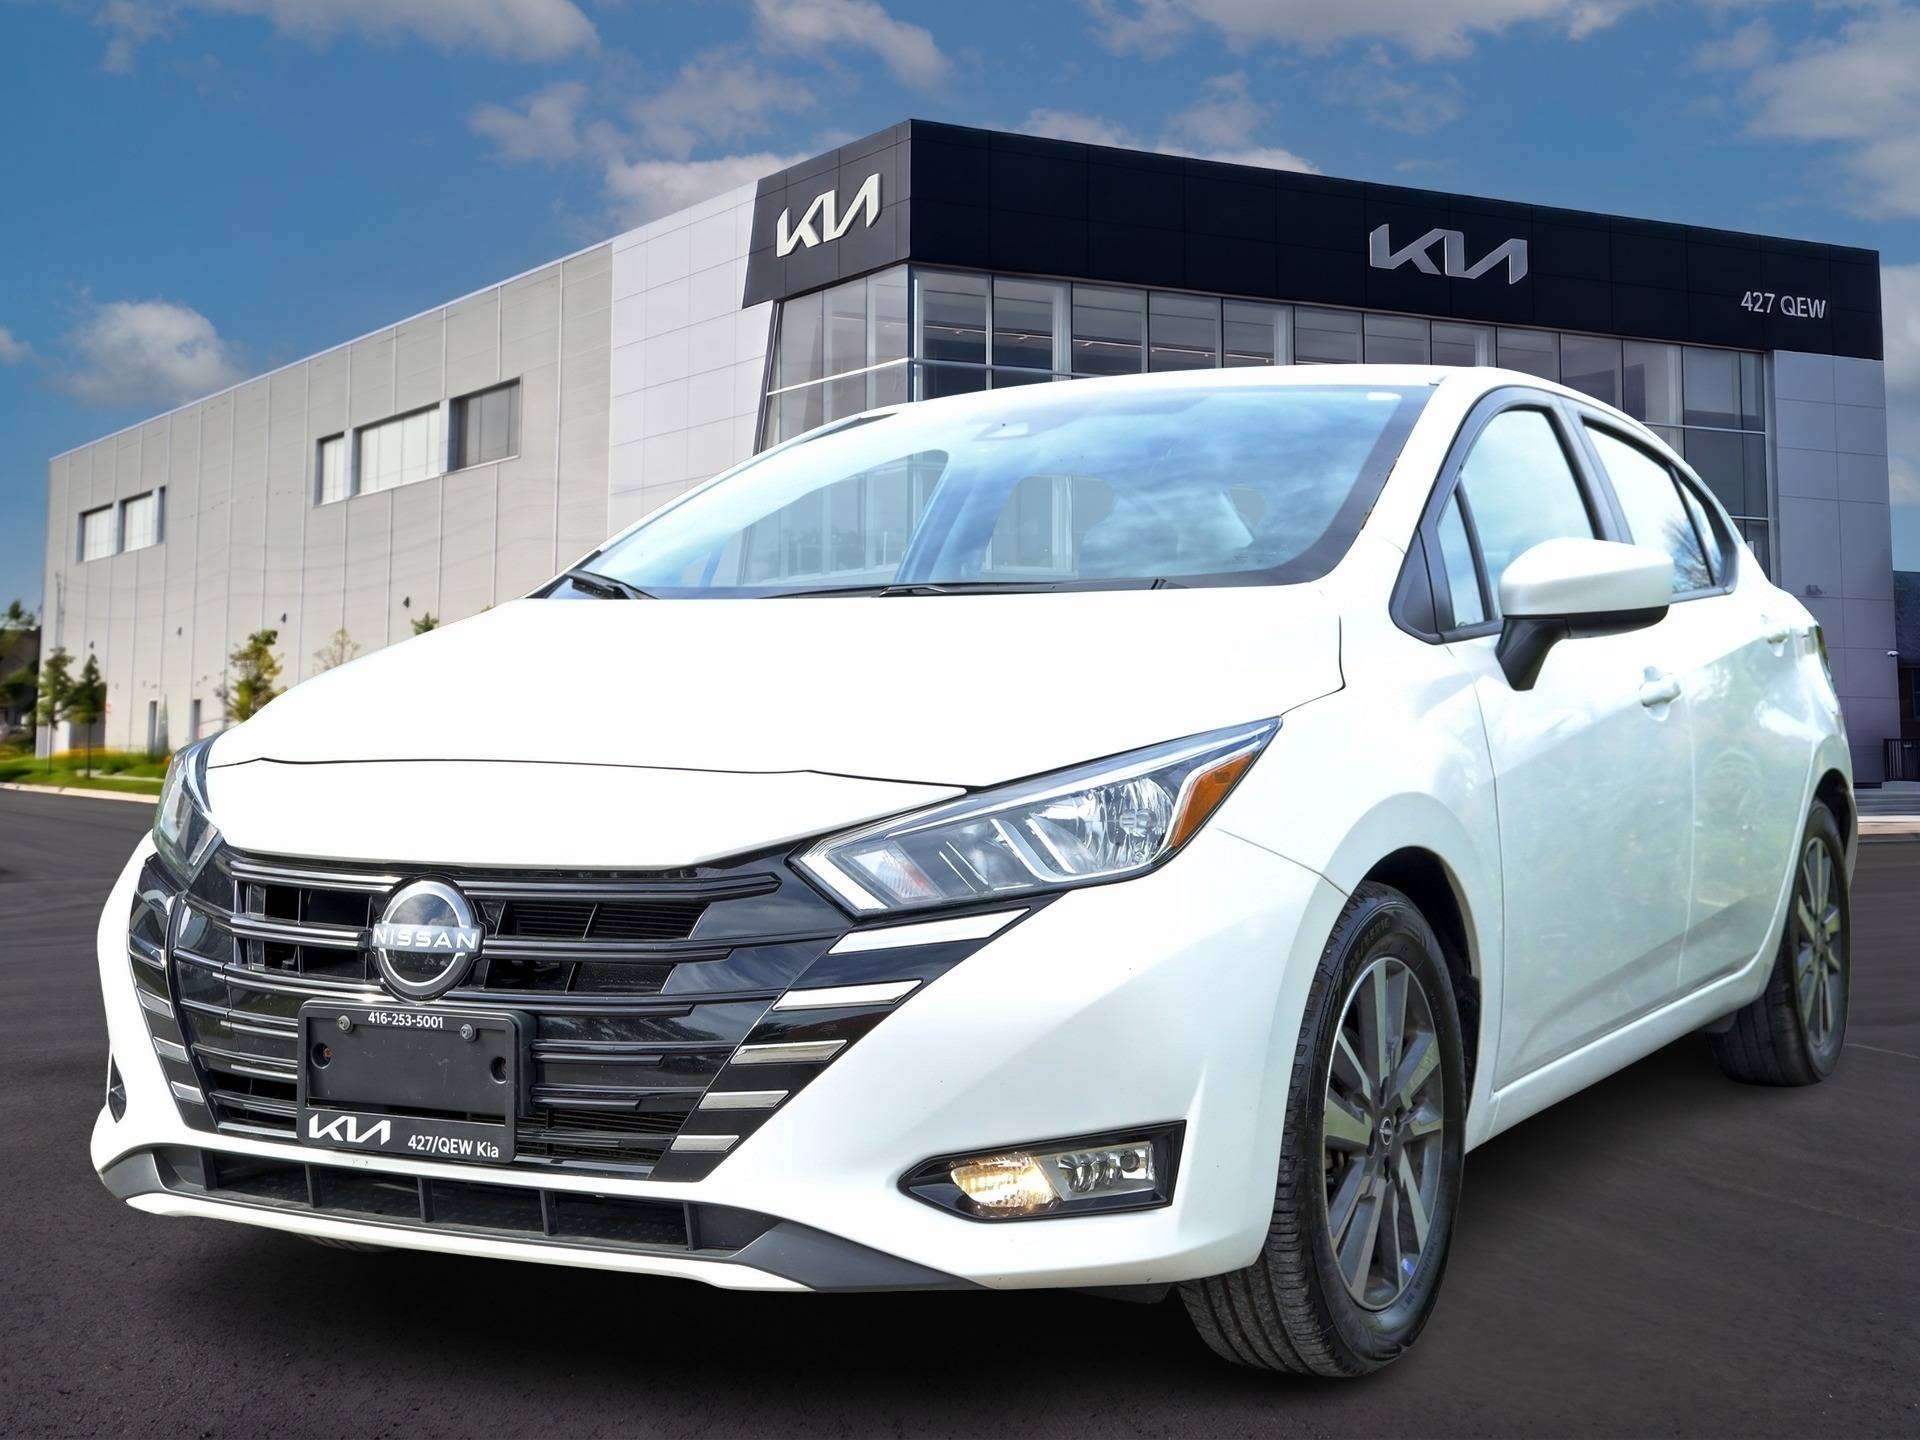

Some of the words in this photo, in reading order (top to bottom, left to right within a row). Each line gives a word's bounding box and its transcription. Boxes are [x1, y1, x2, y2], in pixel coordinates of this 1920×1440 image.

[776, 172, 880, 258] KIA
[1369, 223, 1528, 285] KIA
[1740, 291, 1776, 314] 427
[1780, 295, 1826, 319] QEW
[373, 926, 477, 949] NISSAN
[367, 1011, 444, 1029] 416-253-5001
[308, 1113, 391, 1145] KIA
[407, 1134, 473, 1156] 427/QEW
[476, 1140, 500, 1158] Kia
